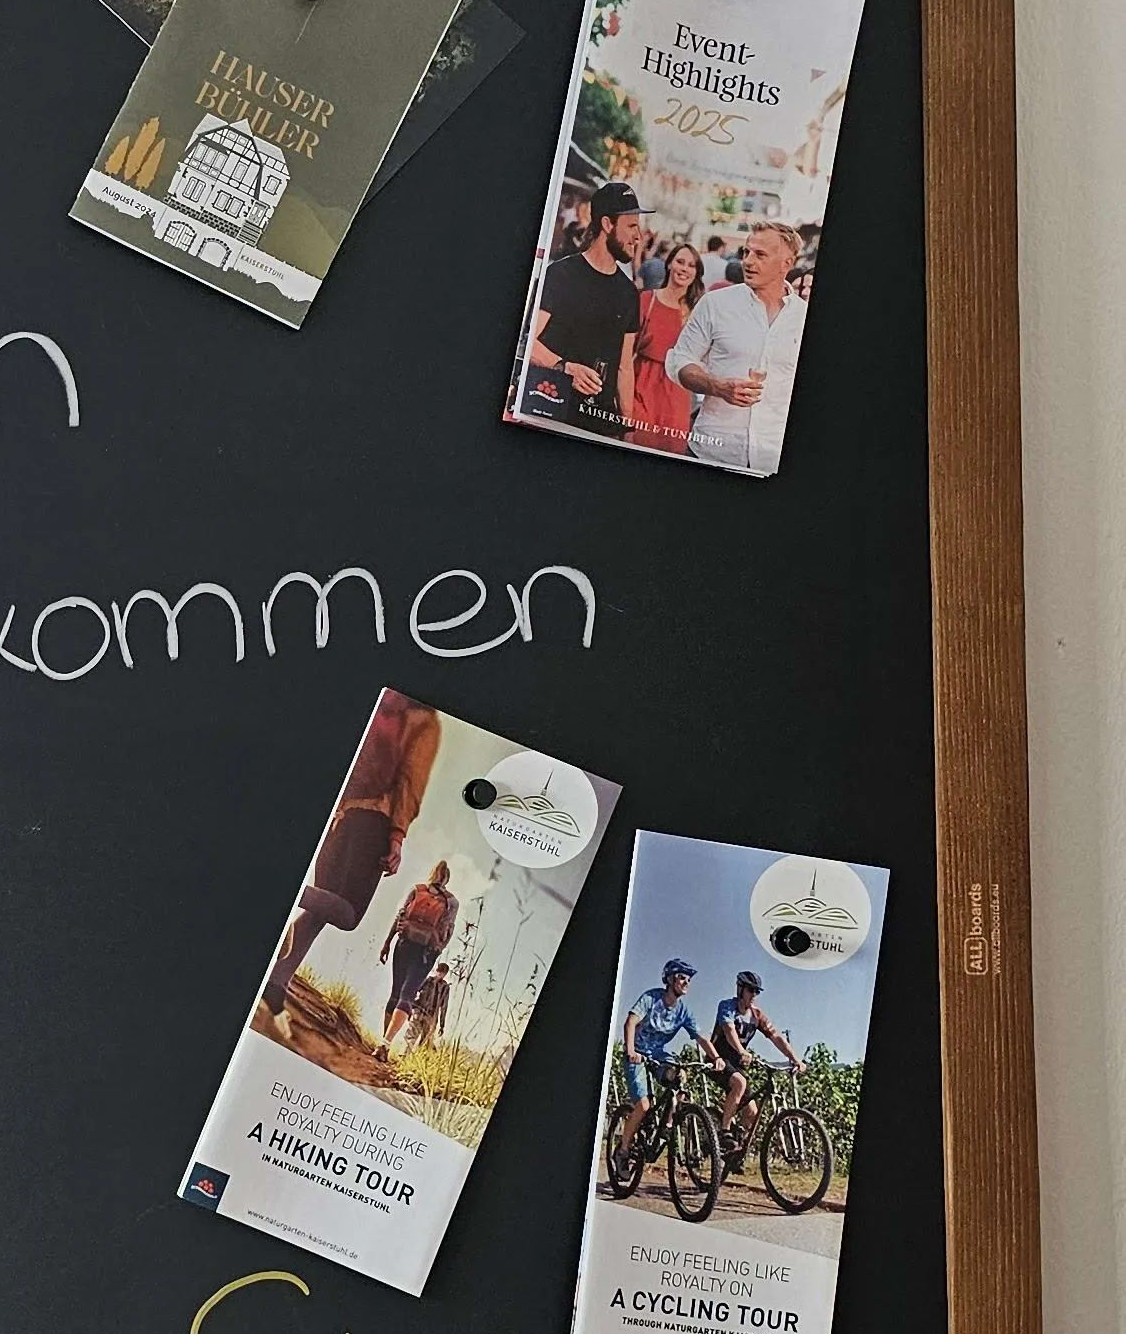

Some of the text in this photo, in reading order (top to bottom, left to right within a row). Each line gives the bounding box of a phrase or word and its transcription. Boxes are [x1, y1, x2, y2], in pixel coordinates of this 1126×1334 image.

[672, 21, 756, 66] Event-
[209, 49, 335, 129] HAUSER
[640, 45, 781, 106] Highlights
[194, 80, 320, 160] BÜHLER
[653, 97, 750, 145] 2025
[102, 186, 157, 218] August 2024
[578, 402, 724, 448] KAISERSTUHL & TUNIBERG
[488, 820, 561, 858] KAISERSTUHL
[270, 1081, 428, 1160] ENJOY FEELING LIKE
[276, 1106, 406, 1171] ROYALTY DURING
[247, 1121, 416, 1206] A HIKING TOUR
[261, 1152, 391, 1214] IN NATURGARTEN KAISERSTUHL
[247, 1208, 359, 1260] www.naturgarten-kaiserstuhl.de
[630, 1245, 792, 1283] ENJOY FEELING LIKE
[660, 1270, 754, 1298] ROYALTY ON
[609, 1287, 800, 1333] A CYCLING TOUR
[622, 1316, 662, 1330] THROUGH
